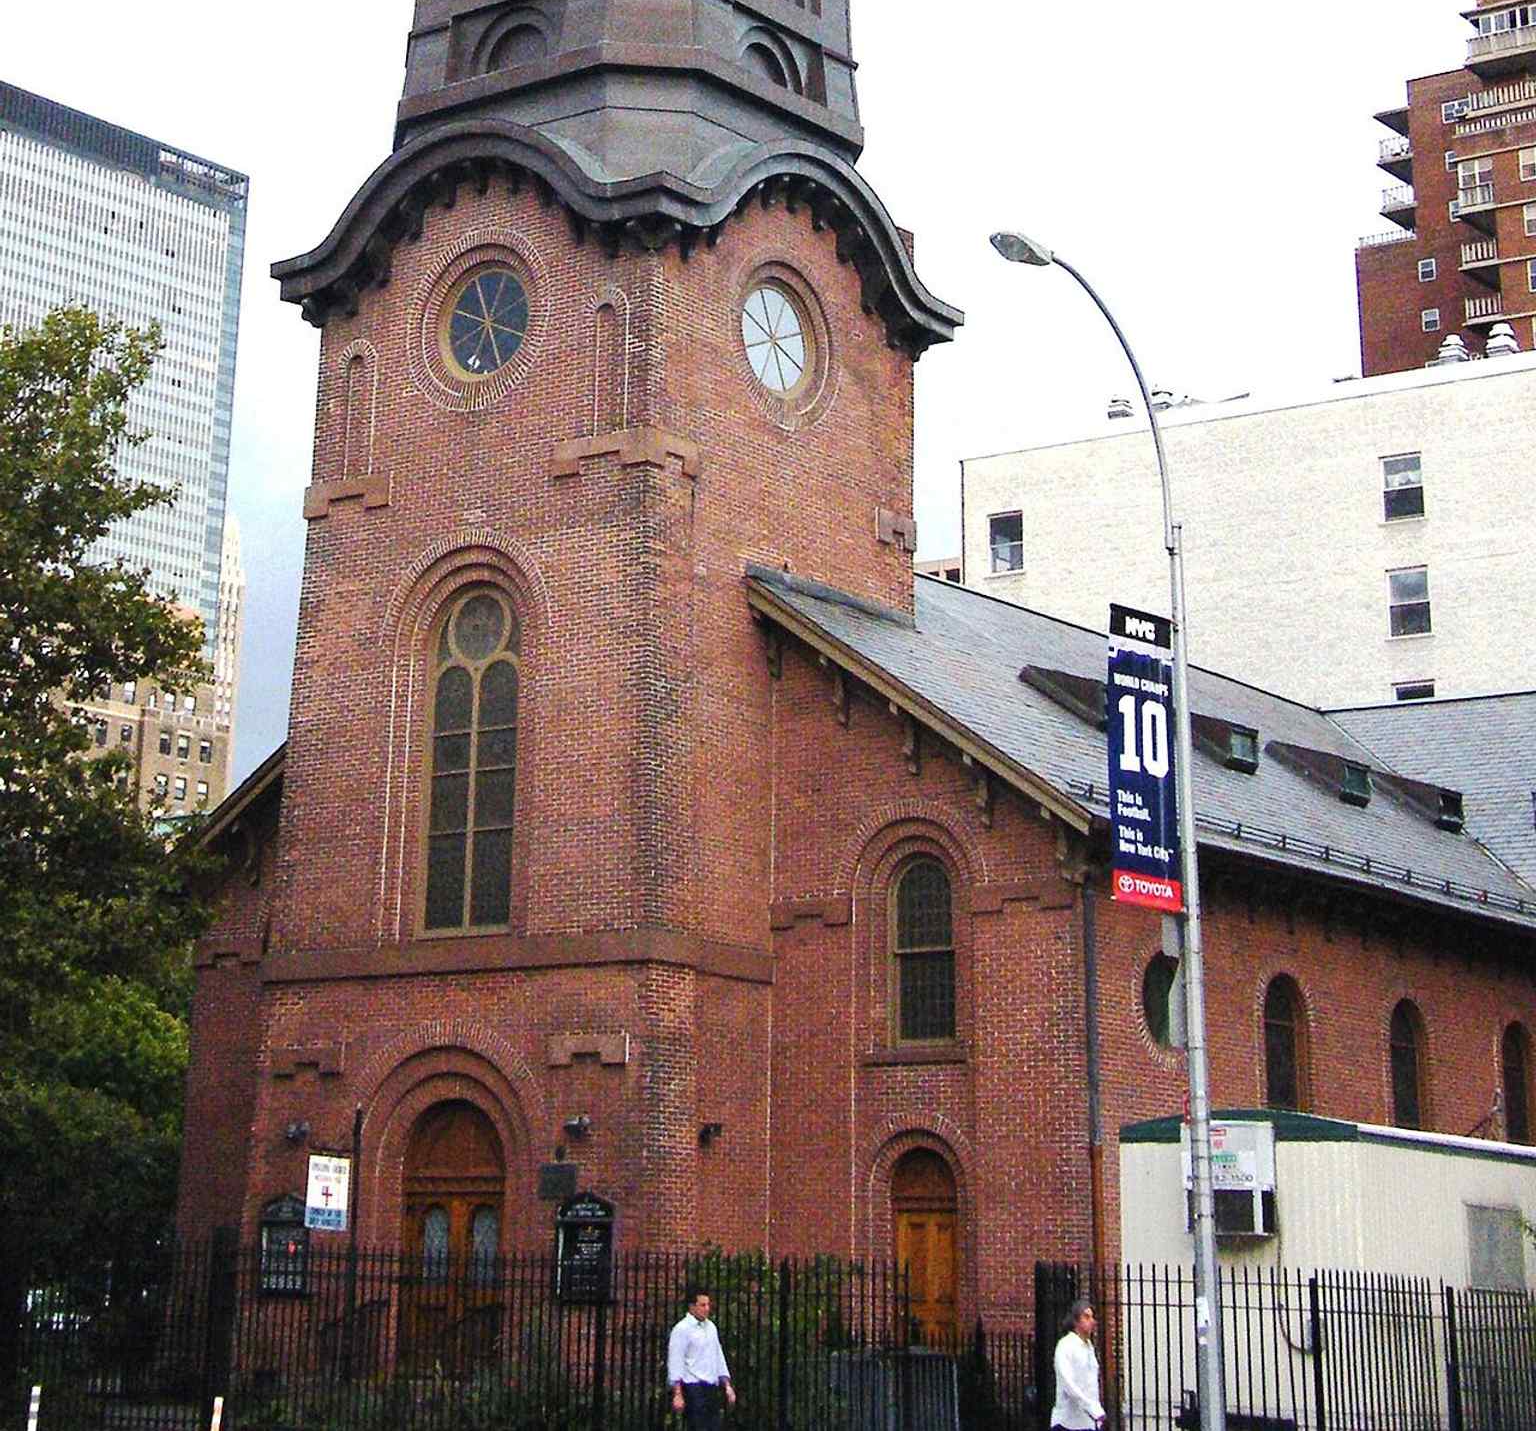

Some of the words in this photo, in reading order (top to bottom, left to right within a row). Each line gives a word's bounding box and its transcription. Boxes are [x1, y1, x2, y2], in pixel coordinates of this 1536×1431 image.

[1125, 616, 1155, 641] NYC
[1119, 695, 1169, 778] 10
[1116, 789, 1135, 805] This
[1118, 825, 1136, 841] This
[1136, 828, 1144, 842] is
[1119, 839, 1136, 853] New
[1137, 842, 1153, 857] York
[1134, 879, 1174, 899] TOYOTA
